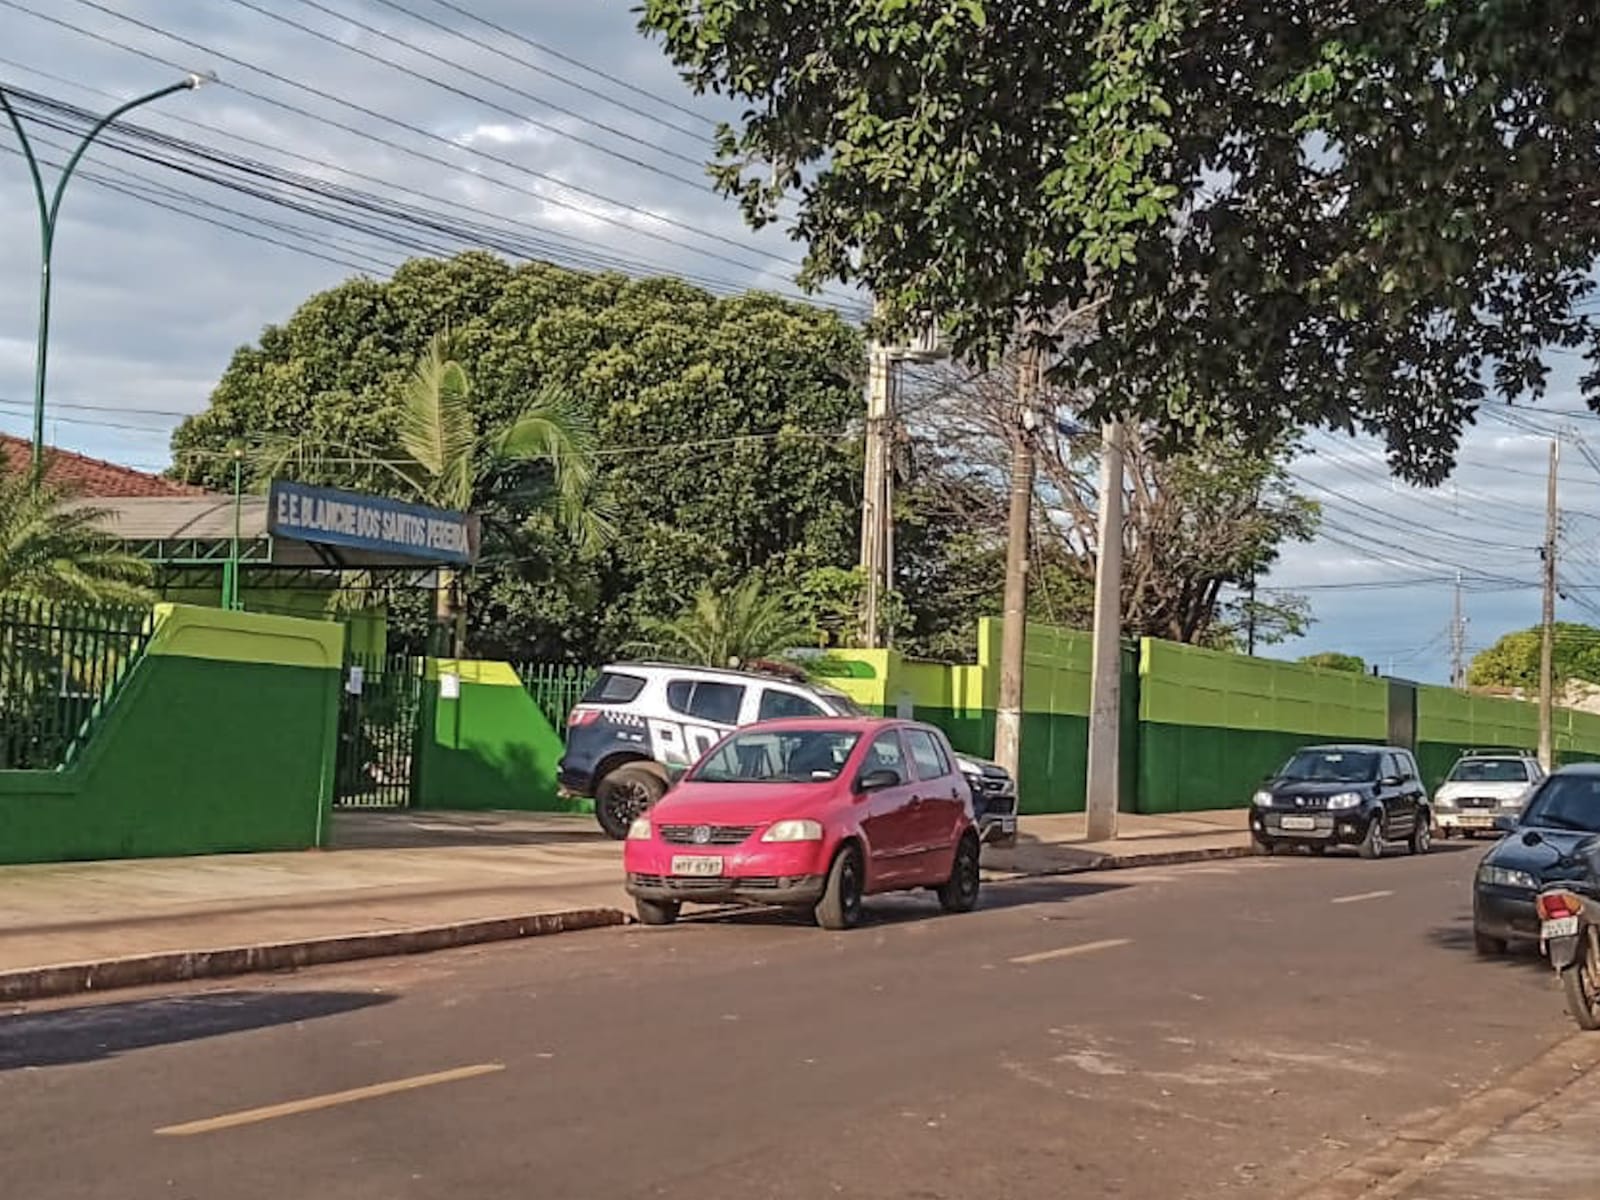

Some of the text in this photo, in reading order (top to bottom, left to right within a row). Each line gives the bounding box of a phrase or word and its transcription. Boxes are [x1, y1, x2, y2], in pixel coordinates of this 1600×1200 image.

[300, 496, 357, 536] BLANCHE
[357, 506, 382, 537] DOS
[382, 510, 425, 547] SANTOS
[427, 517, 470, 556] PEREIRA
